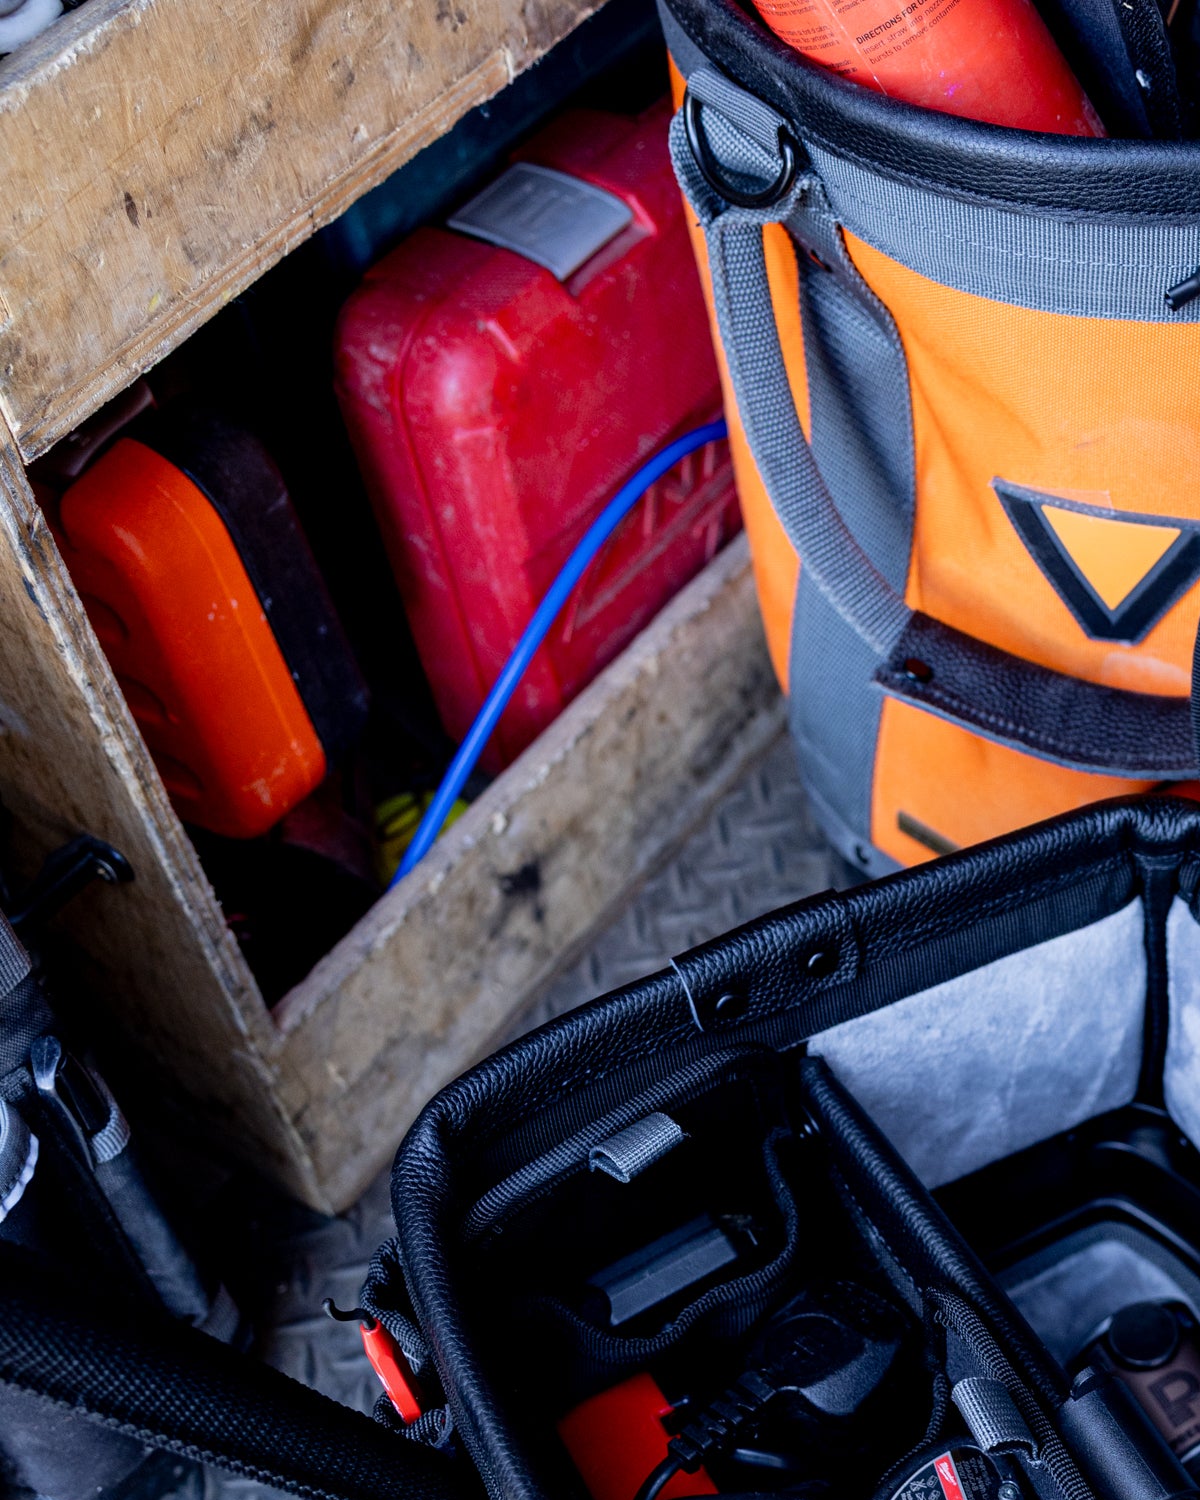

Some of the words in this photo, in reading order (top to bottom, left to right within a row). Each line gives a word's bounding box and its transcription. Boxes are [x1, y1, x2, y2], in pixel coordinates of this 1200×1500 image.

[856, 14, 902, 44] DIRECTIONS
[902, 2, 918, 18] FOR
[863, 40, 886, 55] insert
[887, 26, 908, 43] straw
[910, 15, 924, 28] into
[870, 48, 894, 65] bursts
[894, 44, 901, 53] to
[902, 28, 929, 47] remove
